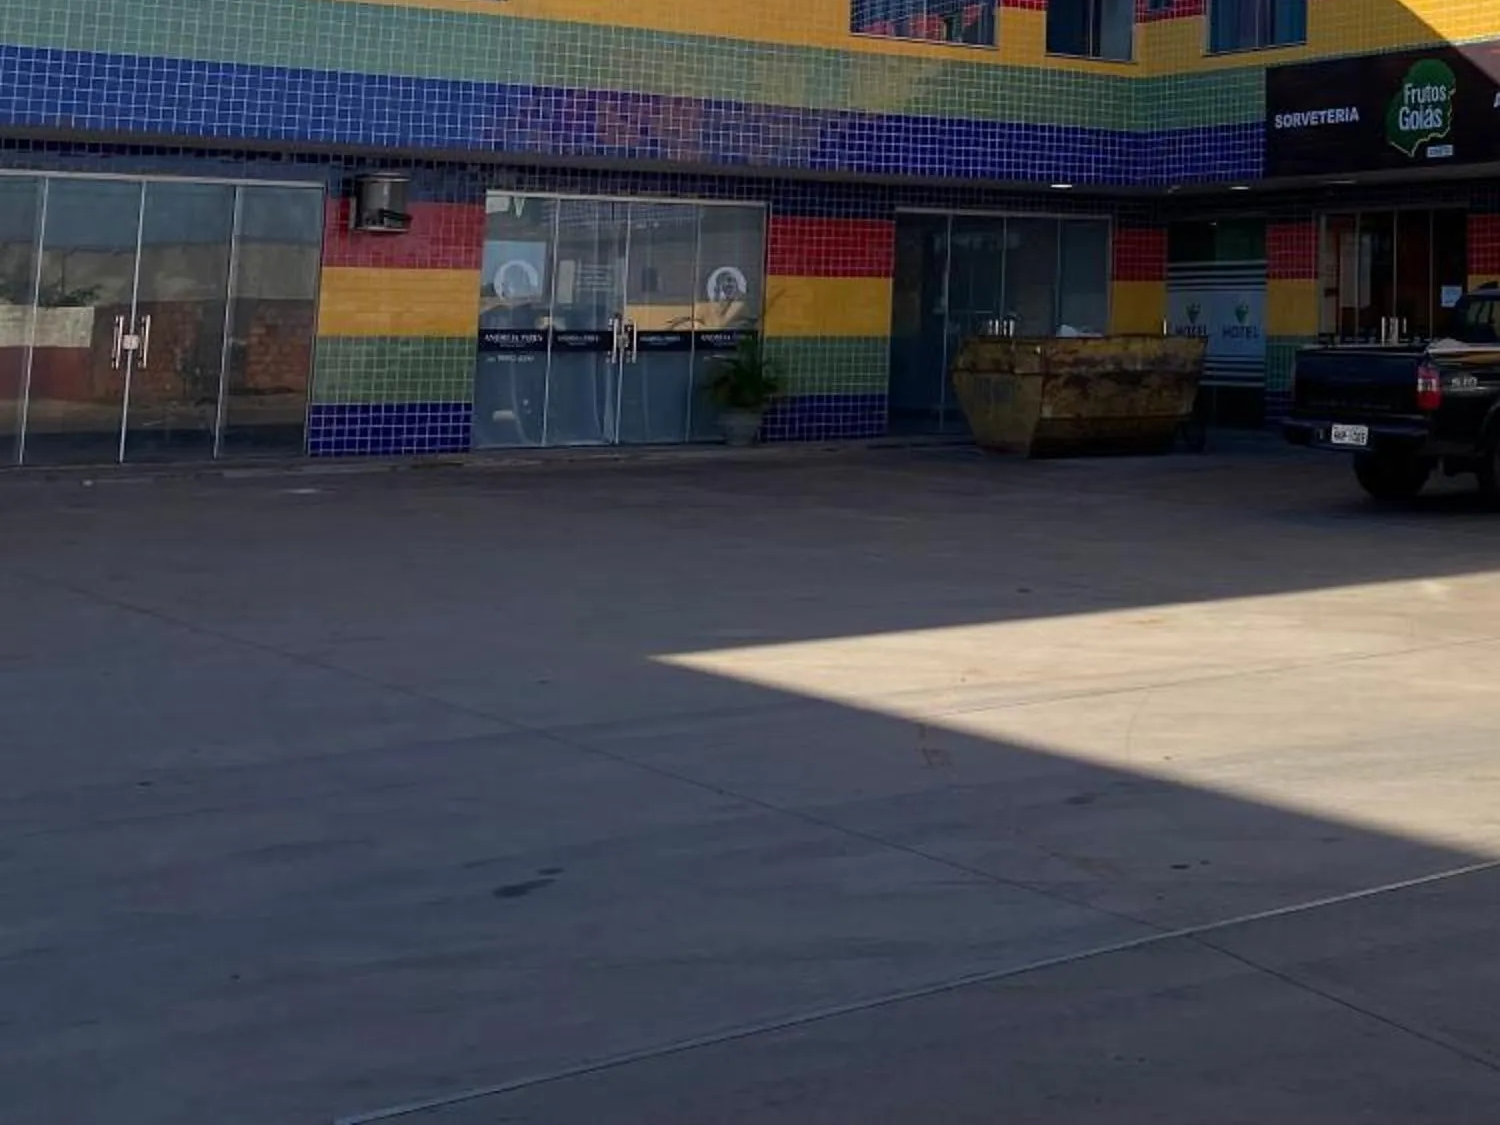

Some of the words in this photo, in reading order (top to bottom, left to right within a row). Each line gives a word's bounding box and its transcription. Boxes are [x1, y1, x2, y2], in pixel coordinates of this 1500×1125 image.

[1403, 82, 1447, 106] Frutos
[1275, 106, 1360, 129] SORVETERIA
[1398, 105, 1443, 131] Goiás
[1222, 324, 1260, 339] HOTEL
